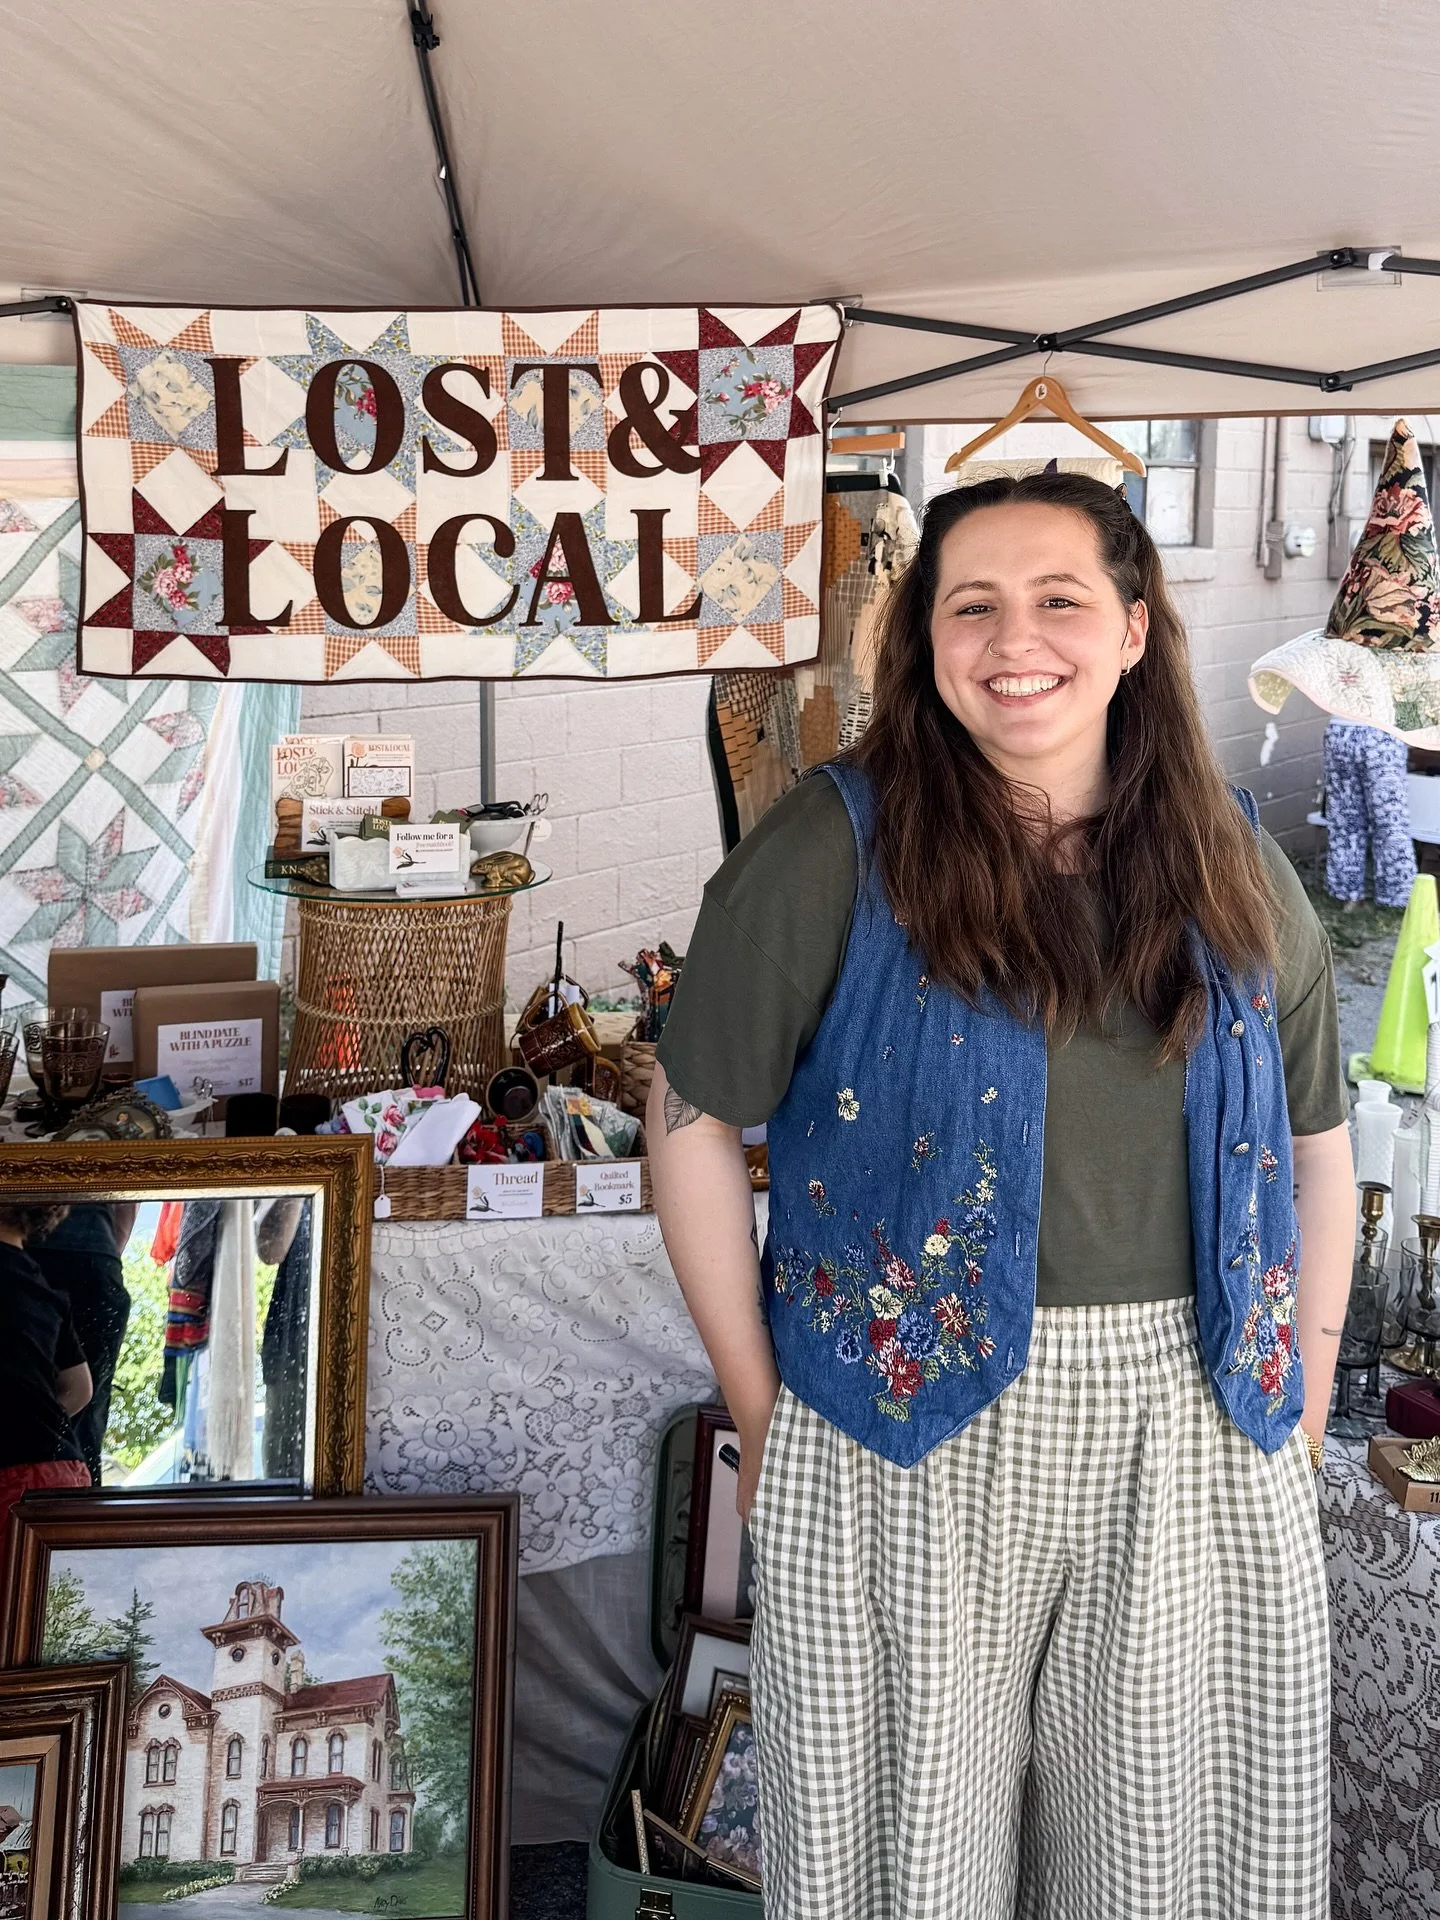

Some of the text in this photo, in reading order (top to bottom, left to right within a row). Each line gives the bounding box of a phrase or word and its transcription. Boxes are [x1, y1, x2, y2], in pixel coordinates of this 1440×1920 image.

[215, 508, 703, 630] LOCAL
[309, 804, 378, 815] Stick & Stitch!
[396, 832, 422, 841] Follow
[436, 832, 447, 840] for
[180, 1027, 241, 1040] BLIND DATE
[169, 1037, 252, 1052] WITH A PUZZLE
[238, 1077, 255, 1087] $17
[493, 1171, 538, 1185] Thread
[600, 1170, 629, 1180] Quilted
[618, 1193, 633, 1205] $5
